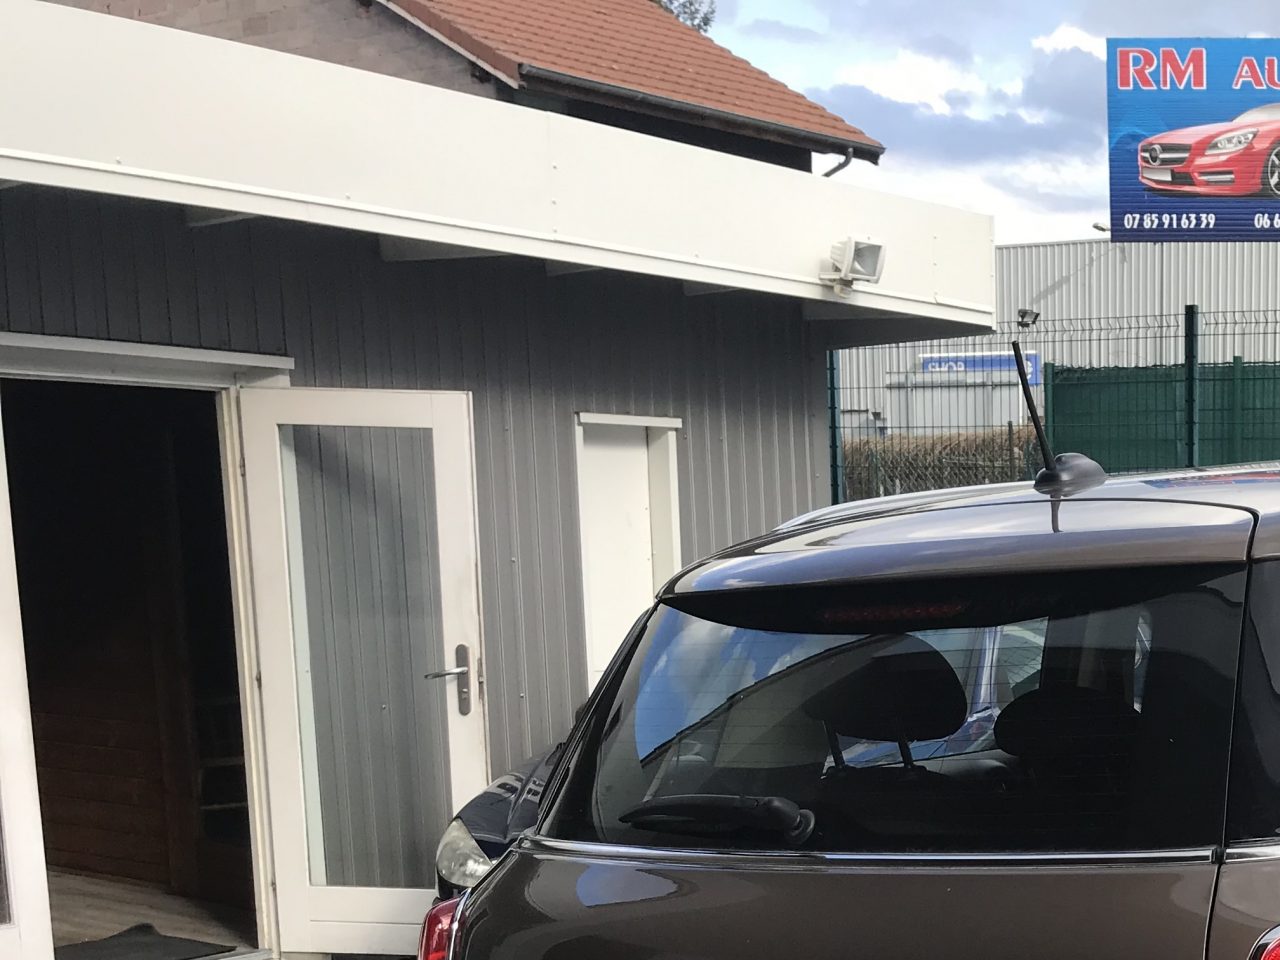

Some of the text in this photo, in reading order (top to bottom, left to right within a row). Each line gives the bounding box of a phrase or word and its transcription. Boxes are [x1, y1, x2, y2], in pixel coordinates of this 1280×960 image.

[1117, 47, 1207, 90] RM
[1123, 213, 1140, 229] 07
[1162, 213, 1178, 229] 91
[1254, 213, 1271, 229] 06
